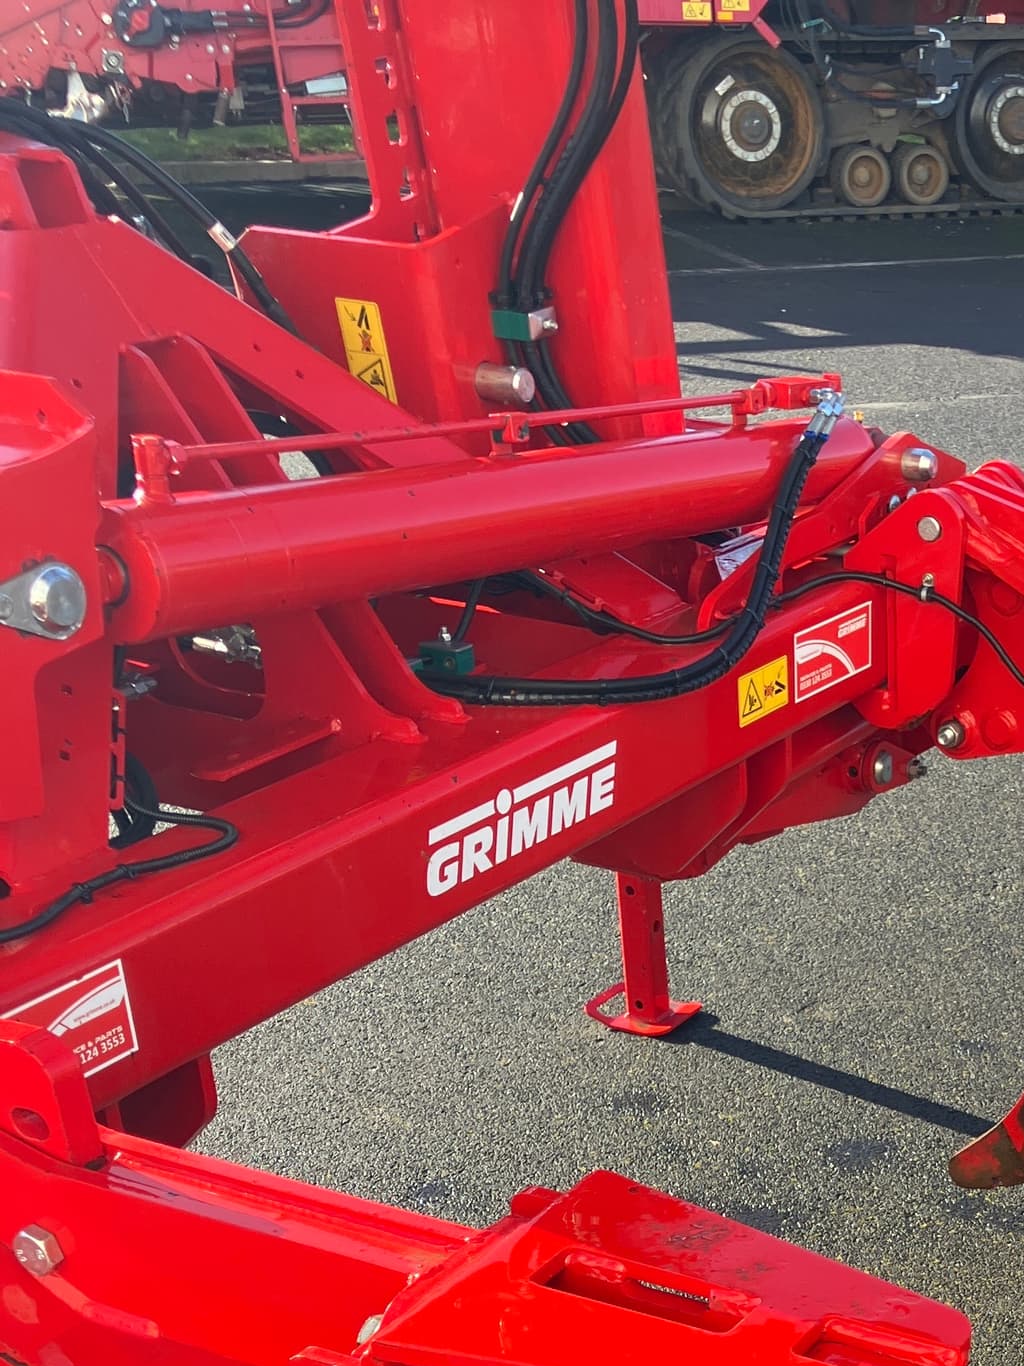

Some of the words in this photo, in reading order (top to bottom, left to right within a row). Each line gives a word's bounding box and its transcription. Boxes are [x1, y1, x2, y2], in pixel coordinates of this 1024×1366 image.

[427, 761, 616, 897] GRIMME
[80, 1046, 98, 1064] 124
[100, 1032, 125, 1053] 3553
